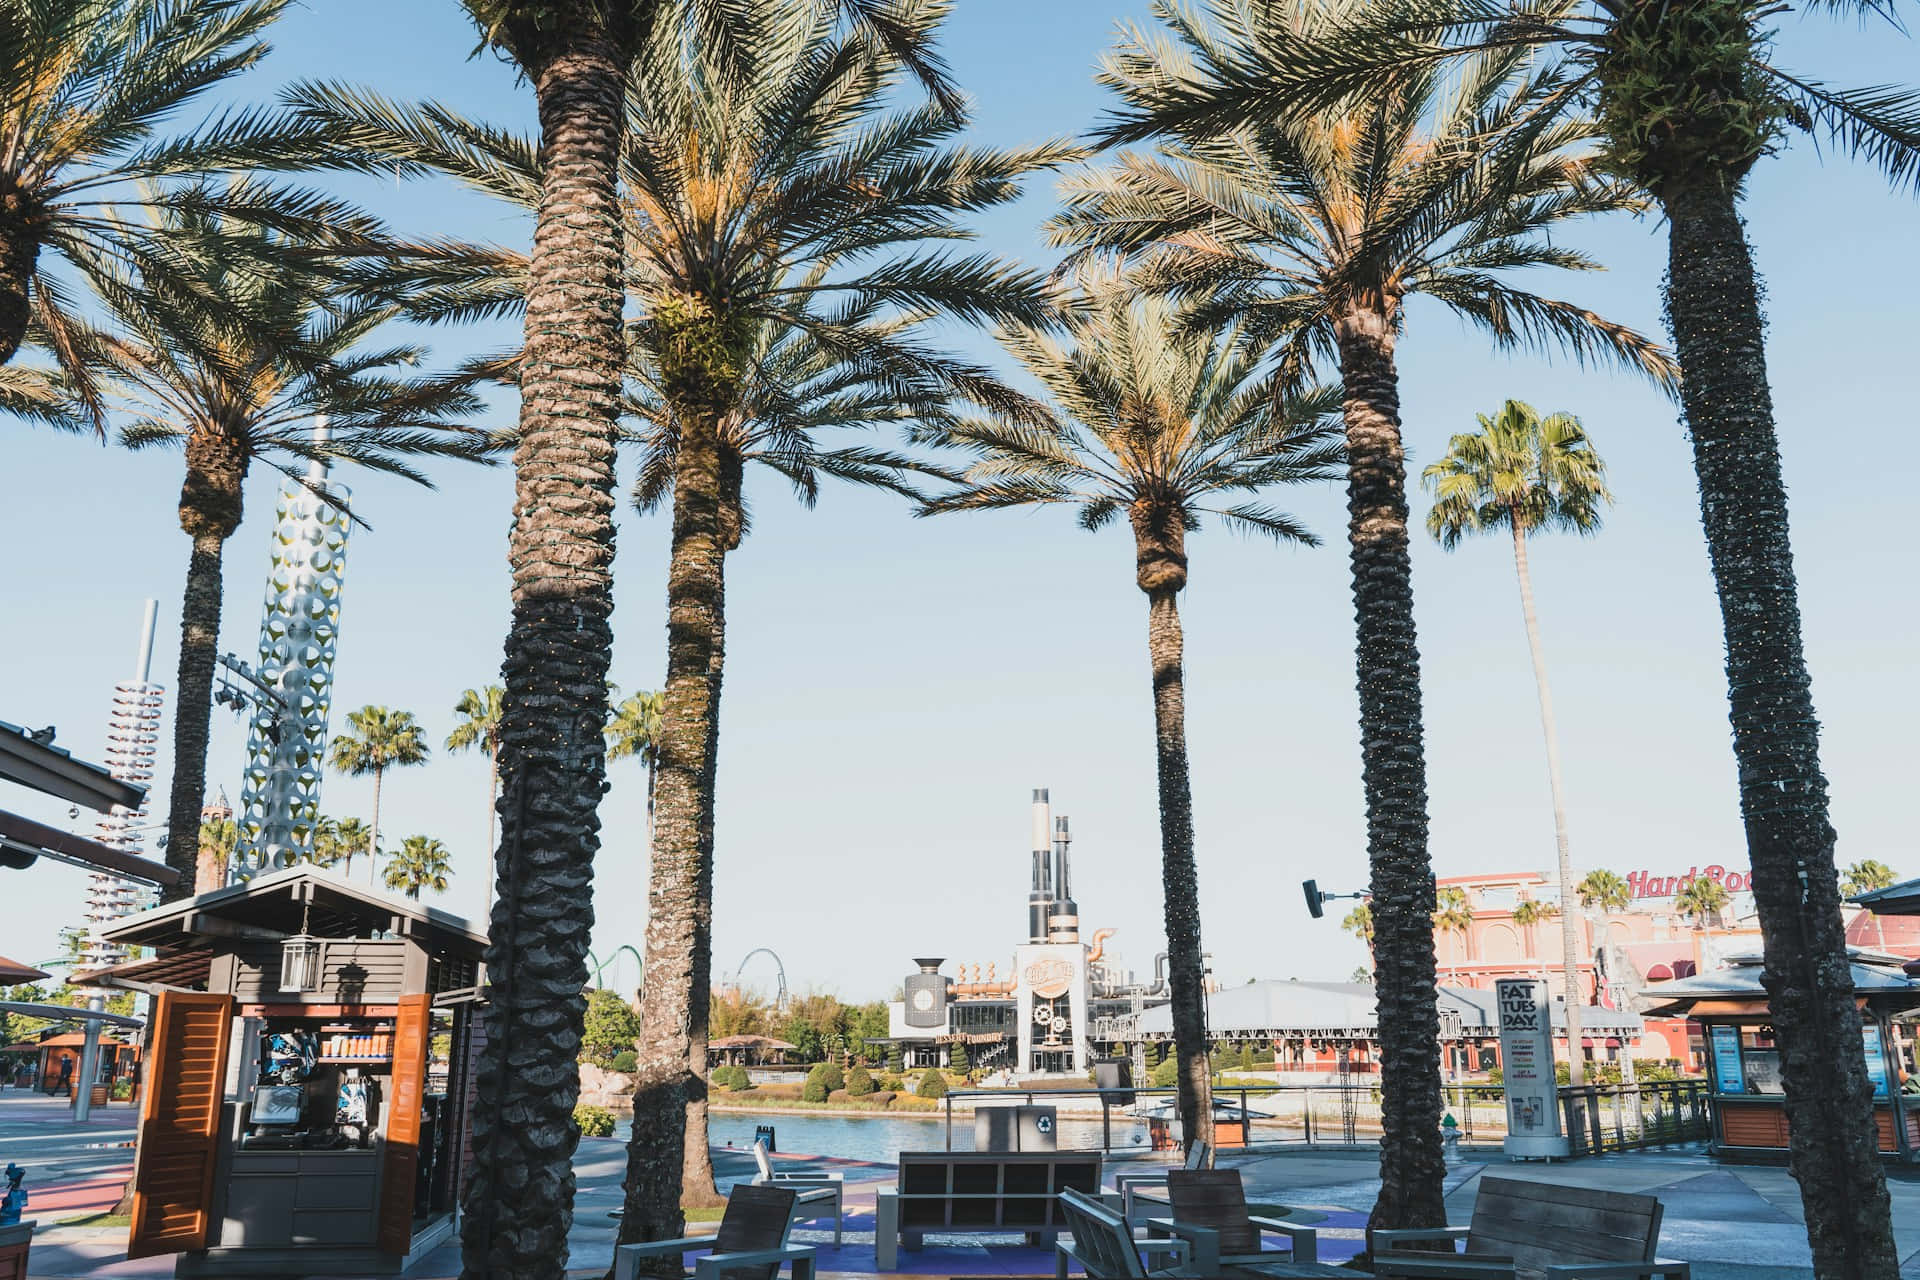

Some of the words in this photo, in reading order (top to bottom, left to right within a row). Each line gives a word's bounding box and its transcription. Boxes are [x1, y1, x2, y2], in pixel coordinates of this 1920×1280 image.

[1627, 867, 1697, 898] Hard
[1501, 985, 1535, 999] FAT
[1502, 1000, 1536, 1013] TUES
